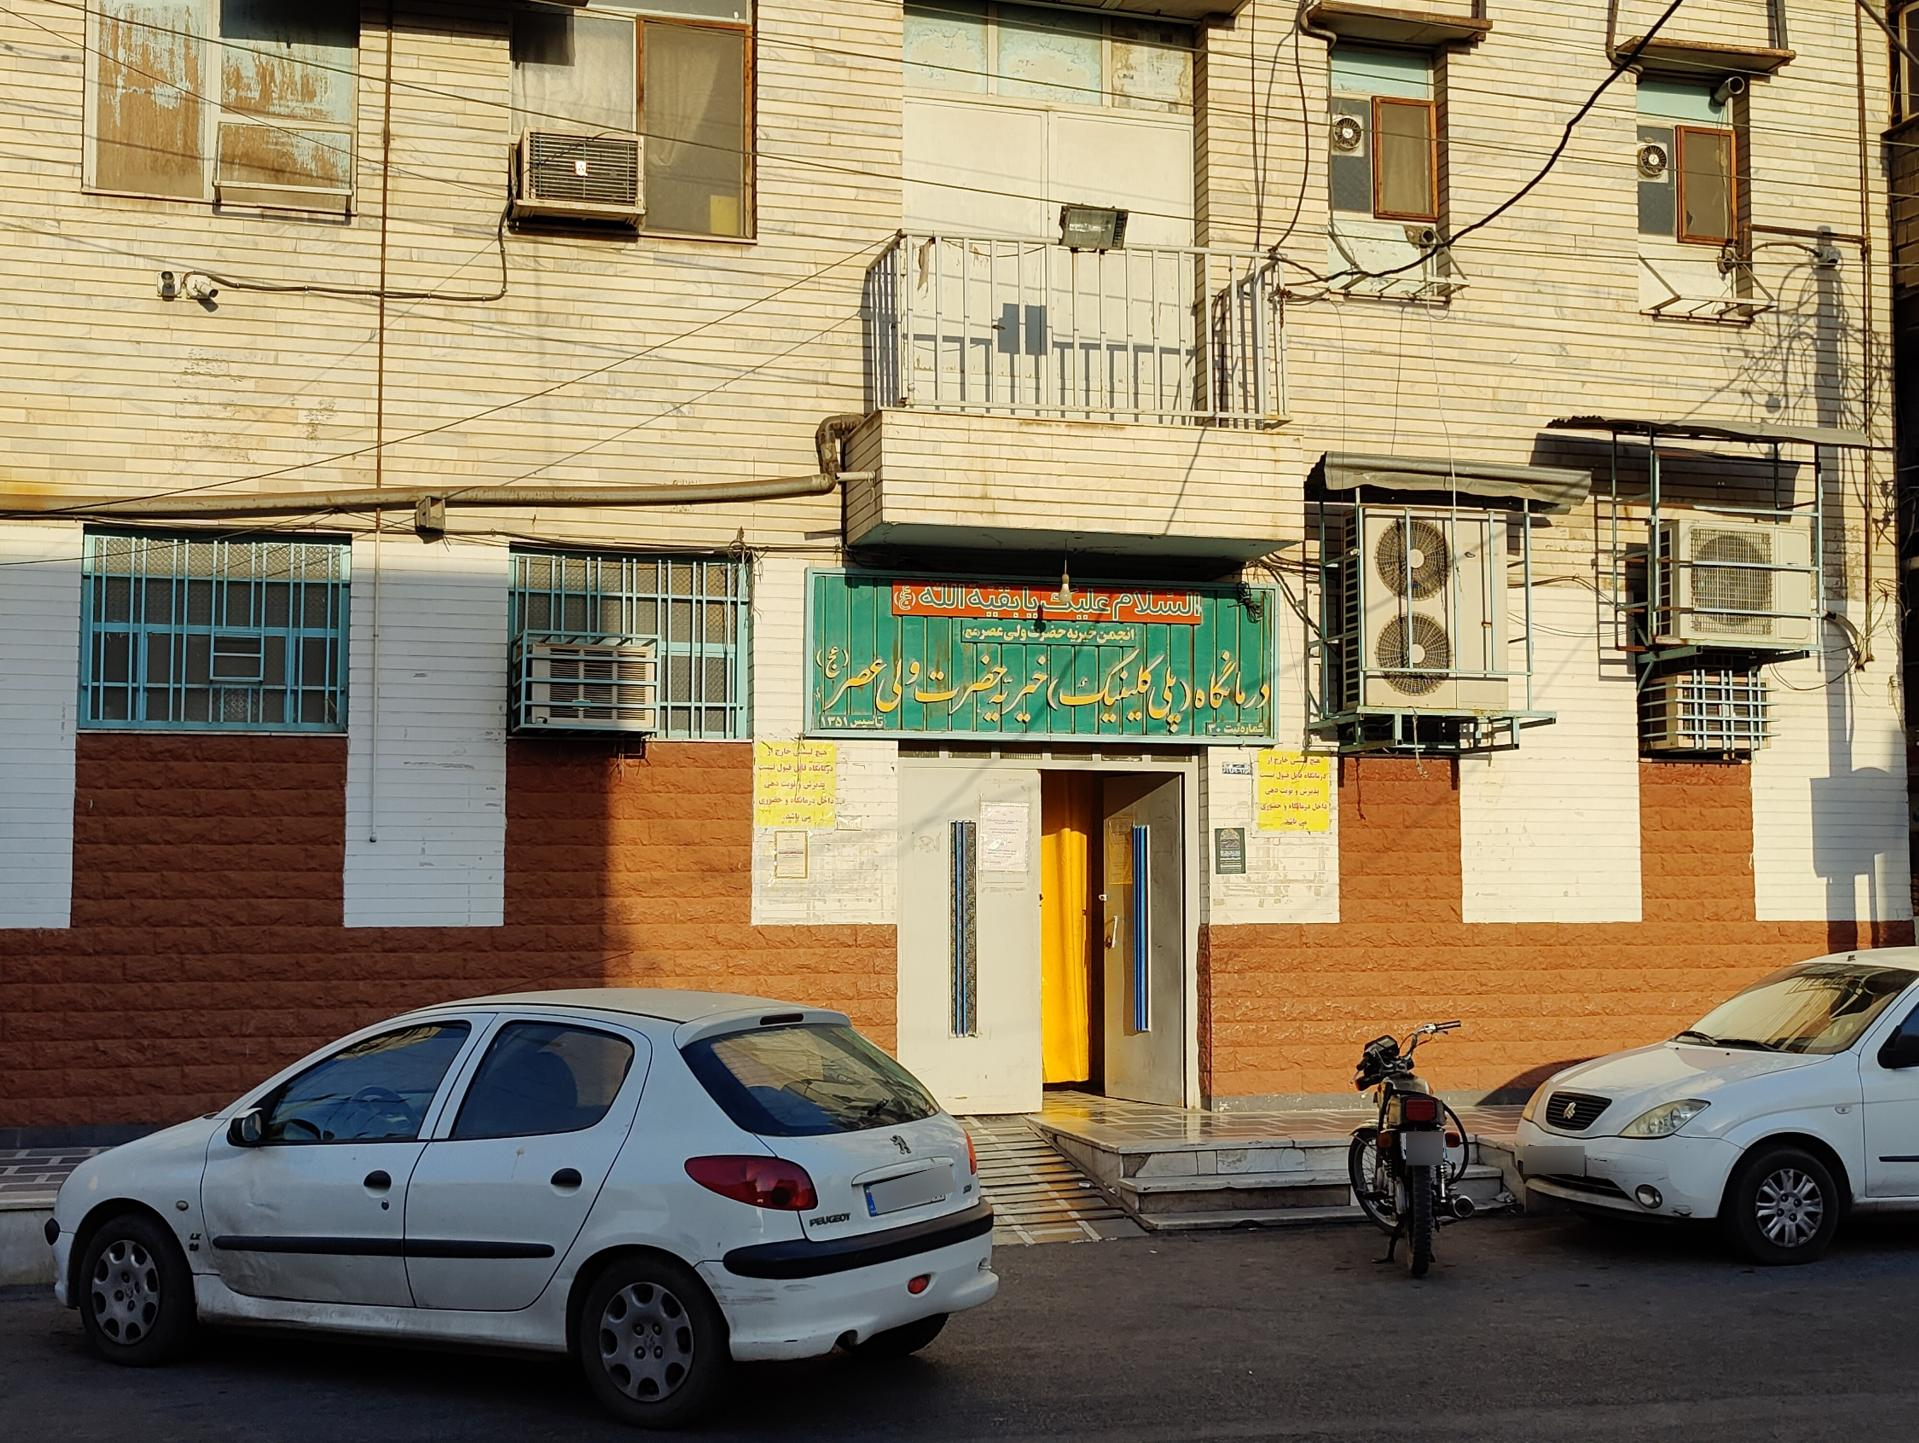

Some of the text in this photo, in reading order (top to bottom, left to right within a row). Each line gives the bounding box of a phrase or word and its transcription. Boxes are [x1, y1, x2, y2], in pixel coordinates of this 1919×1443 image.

[1112, 591, 1202, 621] السلام
[979, 626, 1004, 640] عصر
[1003, 624, 1027, 641] ولی
[1096, 627, 1135, 644] انجمن
[823, 658, 887, 712] عصر
[875, 658, 920, 713] ولی
[914, 655, 1008, 715] حضرت
[1194, 651, 1270, 710] درمانگاه
[809, 1211, 851, 1227] PEUGEOT
